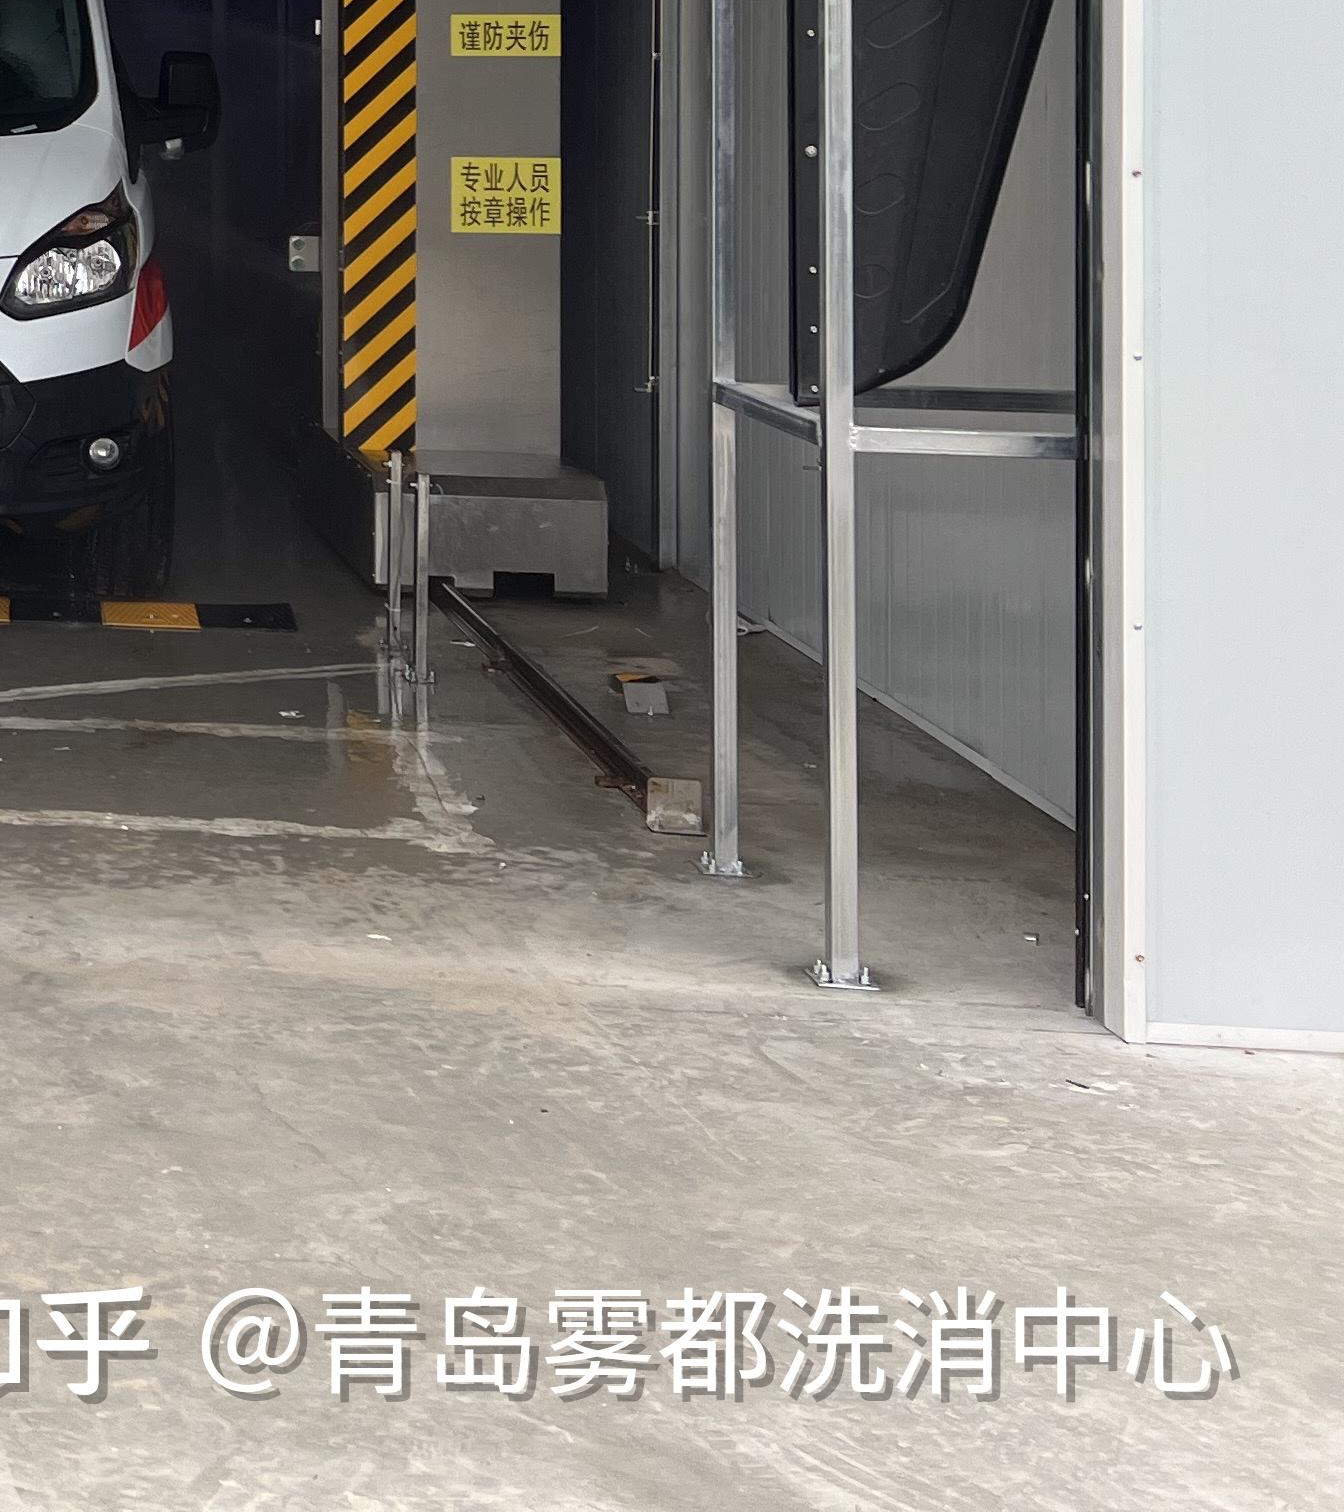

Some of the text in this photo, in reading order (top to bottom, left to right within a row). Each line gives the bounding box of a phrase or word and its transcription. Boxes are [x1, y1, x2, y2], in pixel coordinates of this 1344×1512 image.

[458, 20, 551, 52] 谨防夹伤
[460, 162, 550, 194] 专业人员
[459, 196, 551, 228] 按章操作
